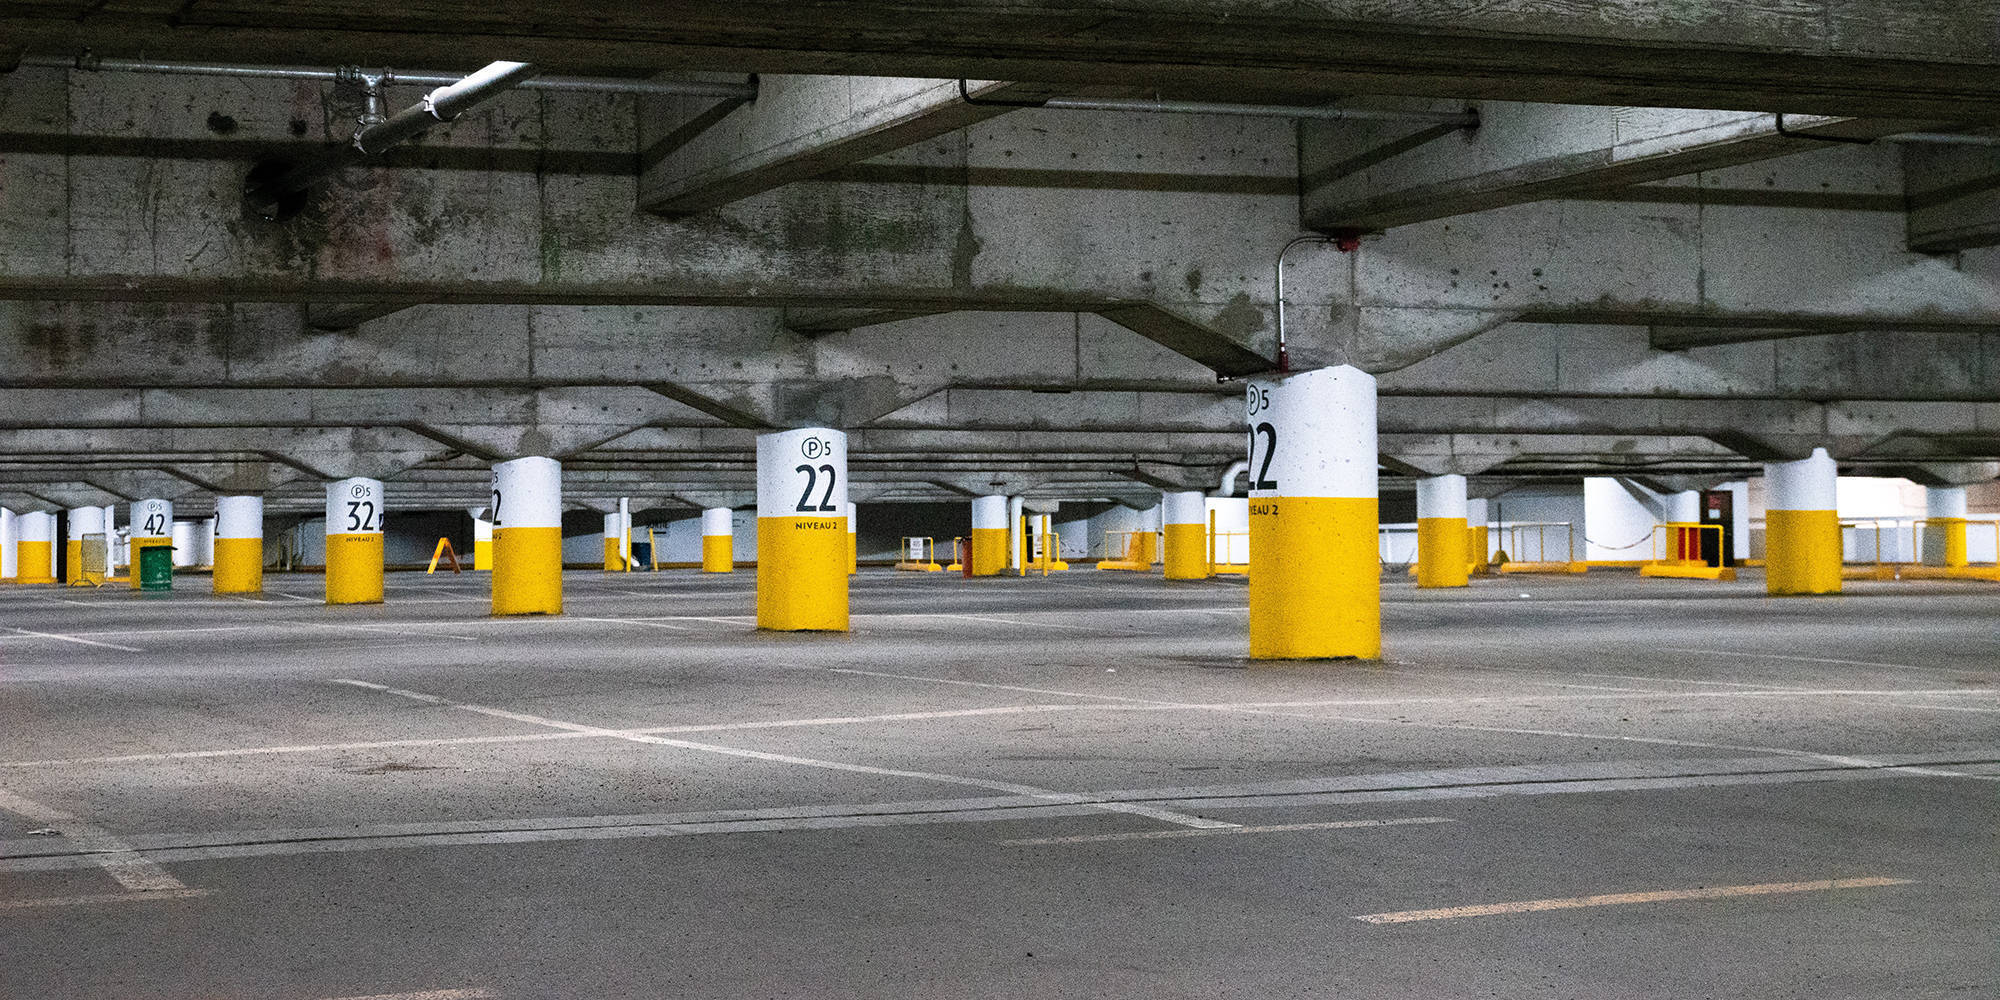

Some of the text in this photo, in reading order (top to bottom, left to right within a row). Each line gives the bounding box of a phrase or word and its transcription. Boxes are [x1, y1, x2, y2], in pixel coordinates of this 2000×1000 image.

[795, 464, 836, 511] 22
[347, 501, 374, 531] 32
[493, 489, 501, 525] 2
[1272, 504, 1279, 516] 2
[144, 513, 165, 536] 42
[214, 511, 220, 536] 2
[795, 521, 838, 530] NIVEAU 2
